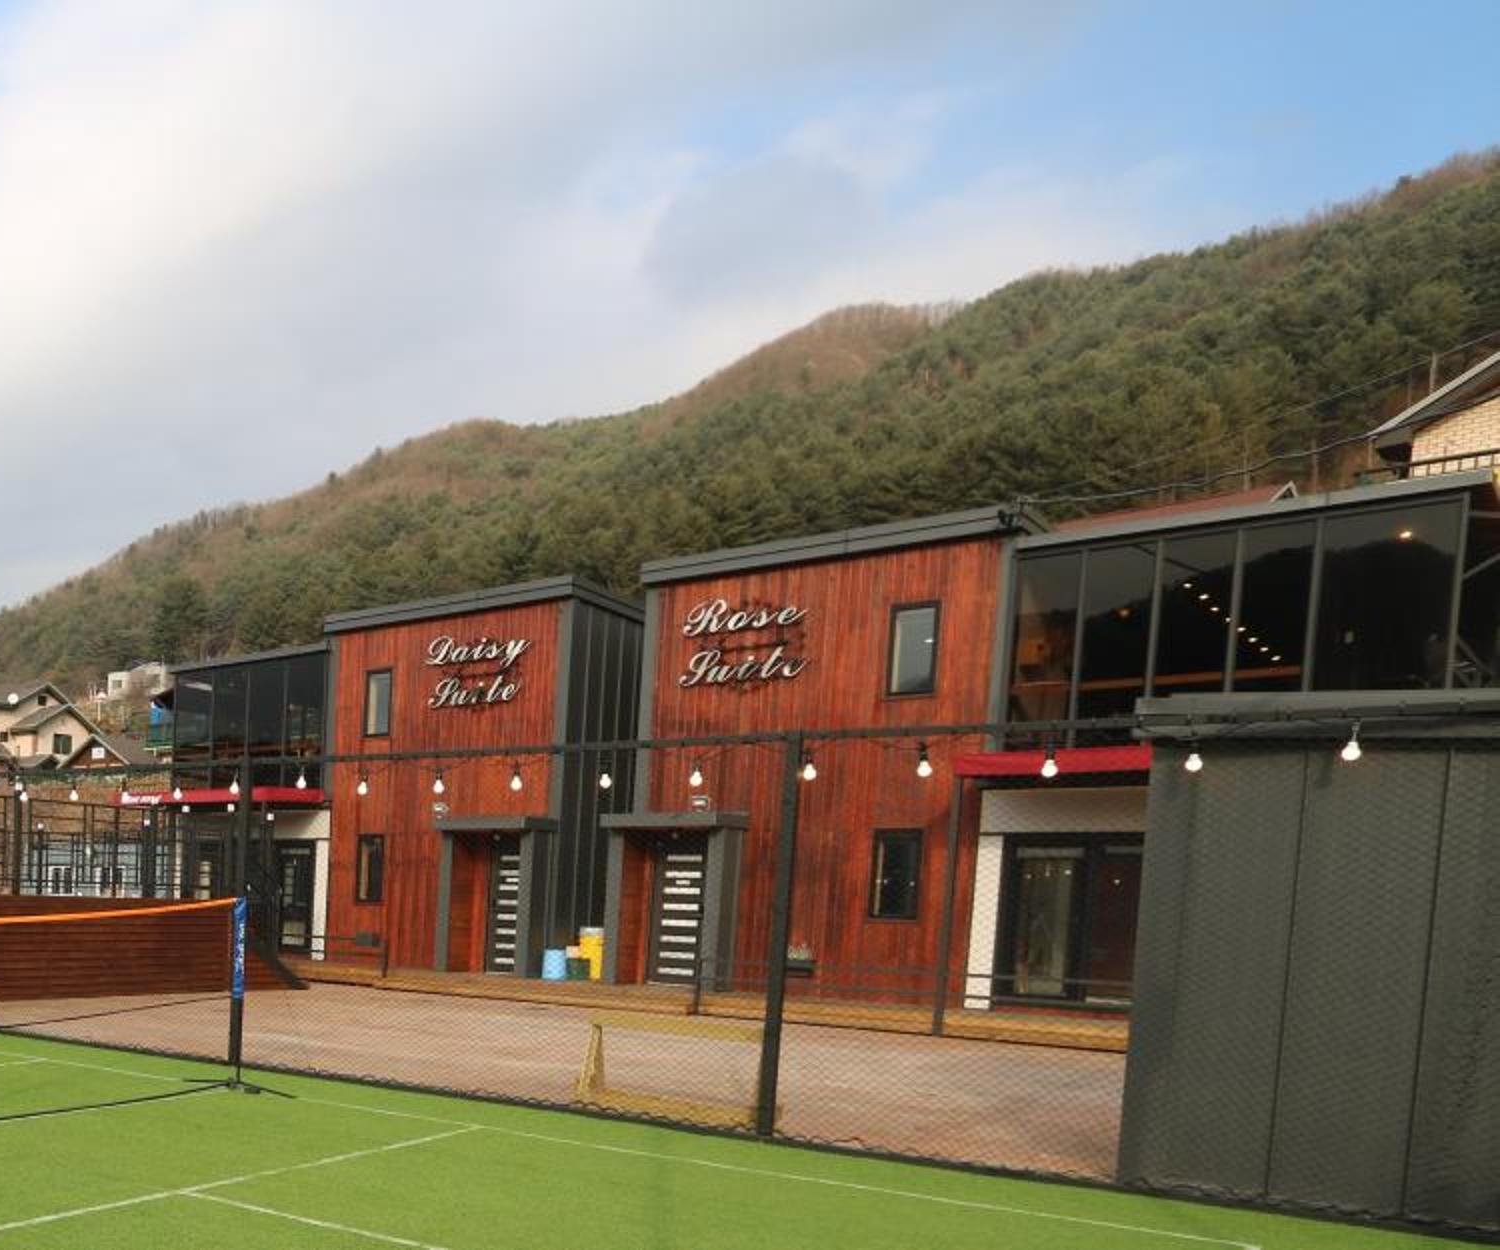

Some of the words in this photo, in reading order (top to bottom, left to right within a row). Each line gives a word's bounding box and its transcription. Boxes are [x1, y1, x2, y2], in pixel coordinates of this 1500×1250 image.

[683, 599, 807, 637] Rose
[425, 635, 532, 669] Daisy
[678, 645, 810, 687] Suite
[427, 675, 522, 709] Suite
